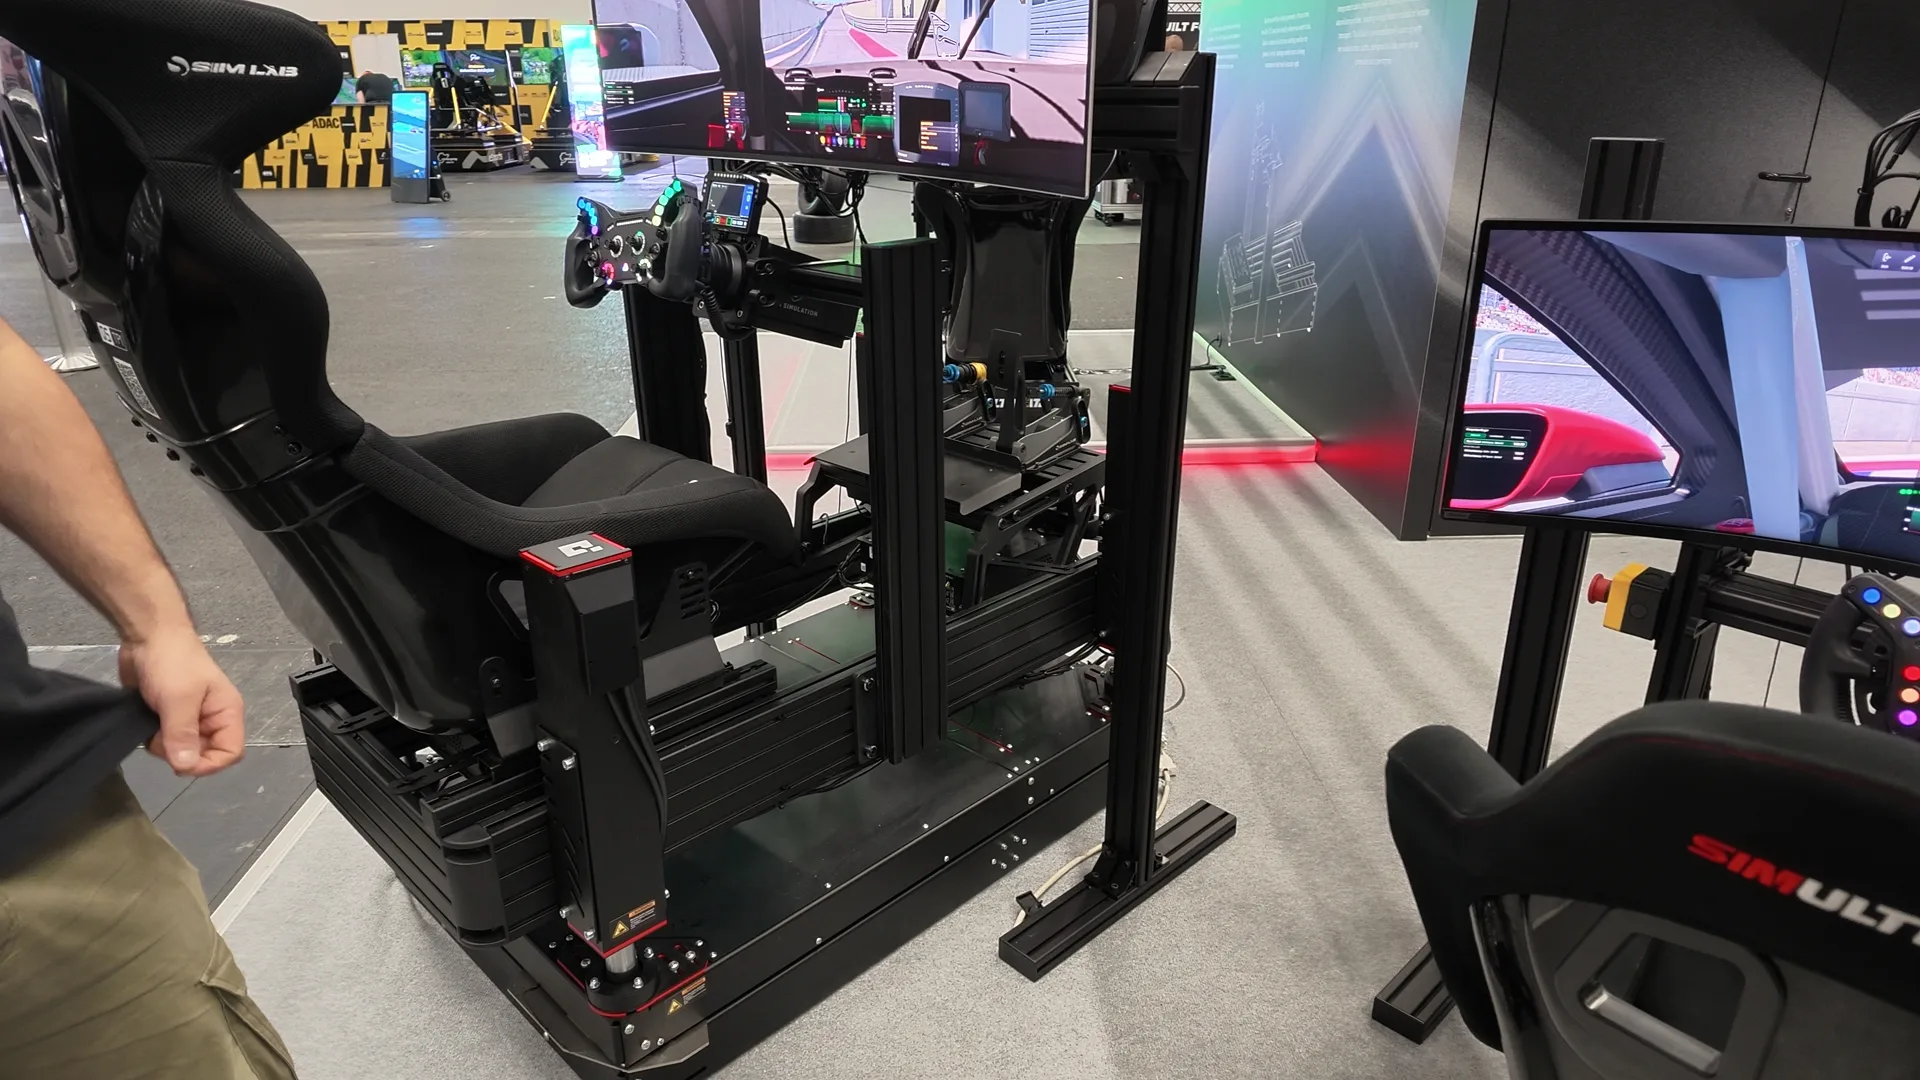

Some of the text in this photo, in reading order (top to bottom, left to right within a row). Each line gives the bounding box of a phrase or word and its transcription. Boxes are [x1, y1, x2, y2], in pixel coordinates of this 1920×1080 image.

[1166, 22, 1190, 32] UILT
[191, 61, 299, 77] SIM LAB
[312, 118, 340, 129] ADAC
[783, 302, 818, 317] SIMULATION
[1687, 833, 1920, 947] SIMULT
